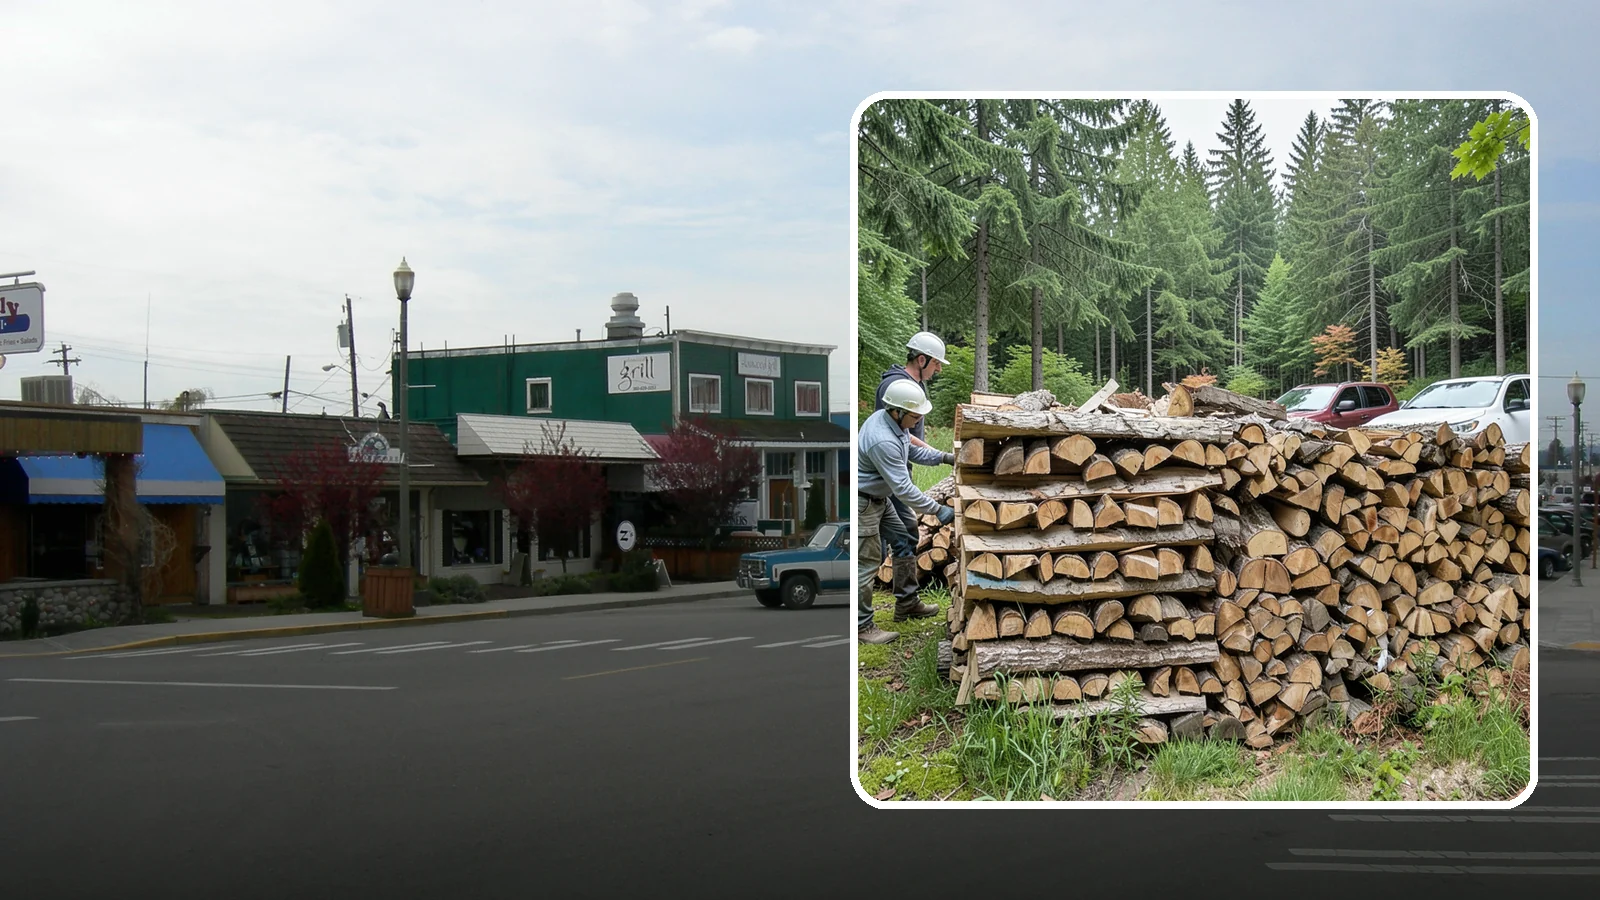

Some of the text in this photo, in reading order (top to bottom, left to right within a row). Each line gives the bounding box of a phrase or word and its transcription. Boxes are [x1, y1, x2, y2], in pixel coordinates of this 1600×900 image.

[3, 336, 38, 346] Fries Salads
[617, 356, 655, 391] grill
